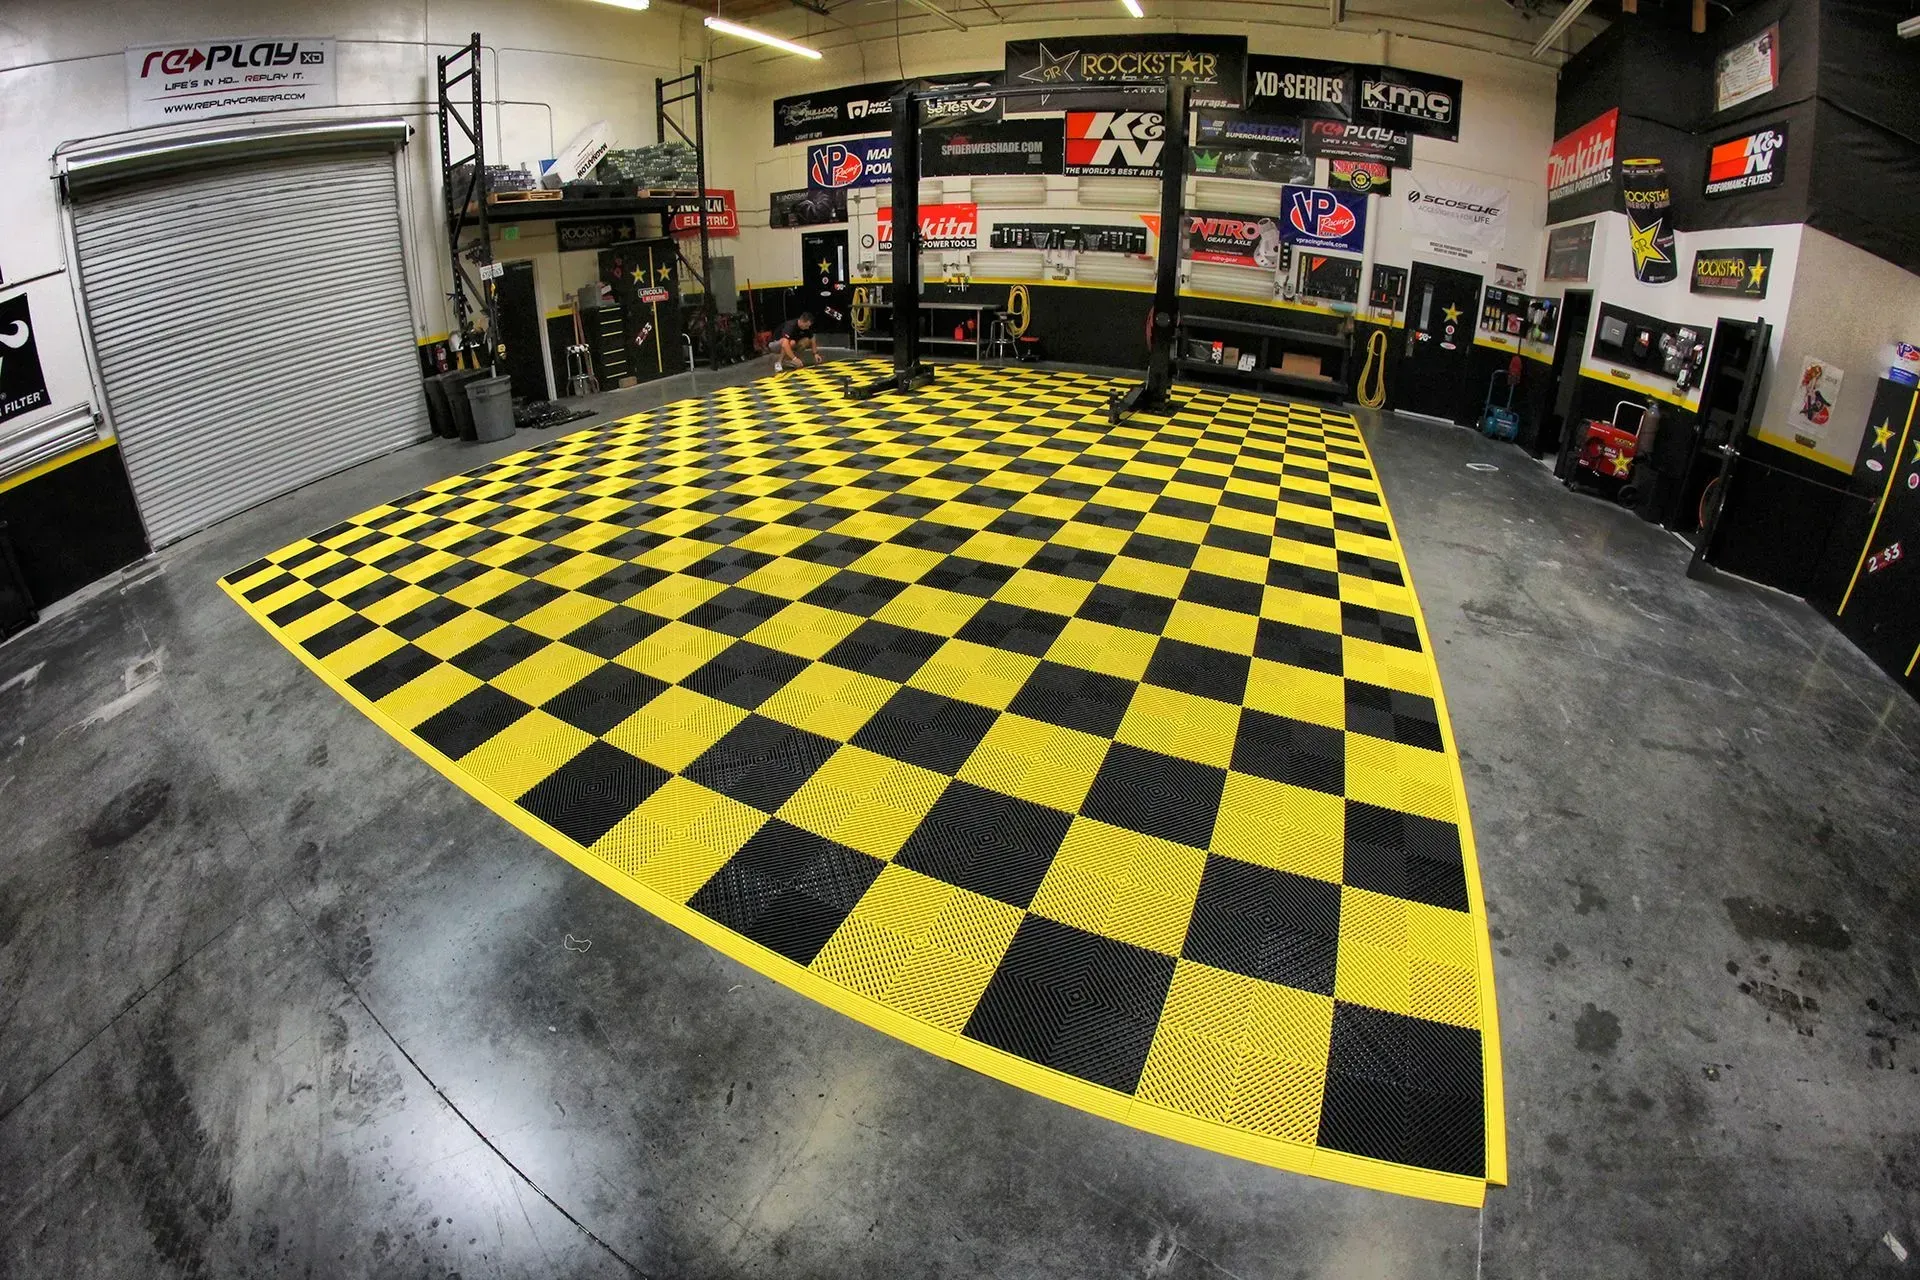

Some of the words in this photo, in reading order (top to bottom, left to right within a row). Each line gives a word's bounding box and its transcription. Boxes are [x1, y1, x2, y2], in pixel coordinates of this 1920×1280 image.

[303, 53, 322, 63] XD
[165, 80, 198, 91] LIFE'S
[204, 78, 214, 87] IN
[245, 73, 288, 82] REPLAY
[293, 72, 304, 80] IT.
[164, 93, 306, 114] WWW.REPLAYCAMERA.COM
[1368, 100, 1444, 121] WHEELS
[1227, 120, 1302, 136] VORTECH
[1226, 132, 1284, 142] SUPERCHARGERS
[941, 141, 1043, 156] SPIDERWEBSHADE.COM
[1743, 130, 1783, 175] K&N
[813, 144, 848, 187] VP
[1082, 167, 1114, 176] WORLD'S
[1114, 168, 1138, 176] BEST
[1593, 168, 1611, 185] TOOLS
[1705, 177, 1748, 194] PERFORMANCE
[1747, 172, 1773, 186] FILTERS
[1292, 190, 1337, 236] VP
[1423, 195, 1500, 216] SCOSCHE
[1189, 217, 1260, 240] NITRO
[1321, 217, 1354, 230] Racing
[1474, 216, 1490, 224] LIFE
[1296, 238, 1348, 248] vpracingfuels.com
[640, 288, 663, 296] LINCOLN
